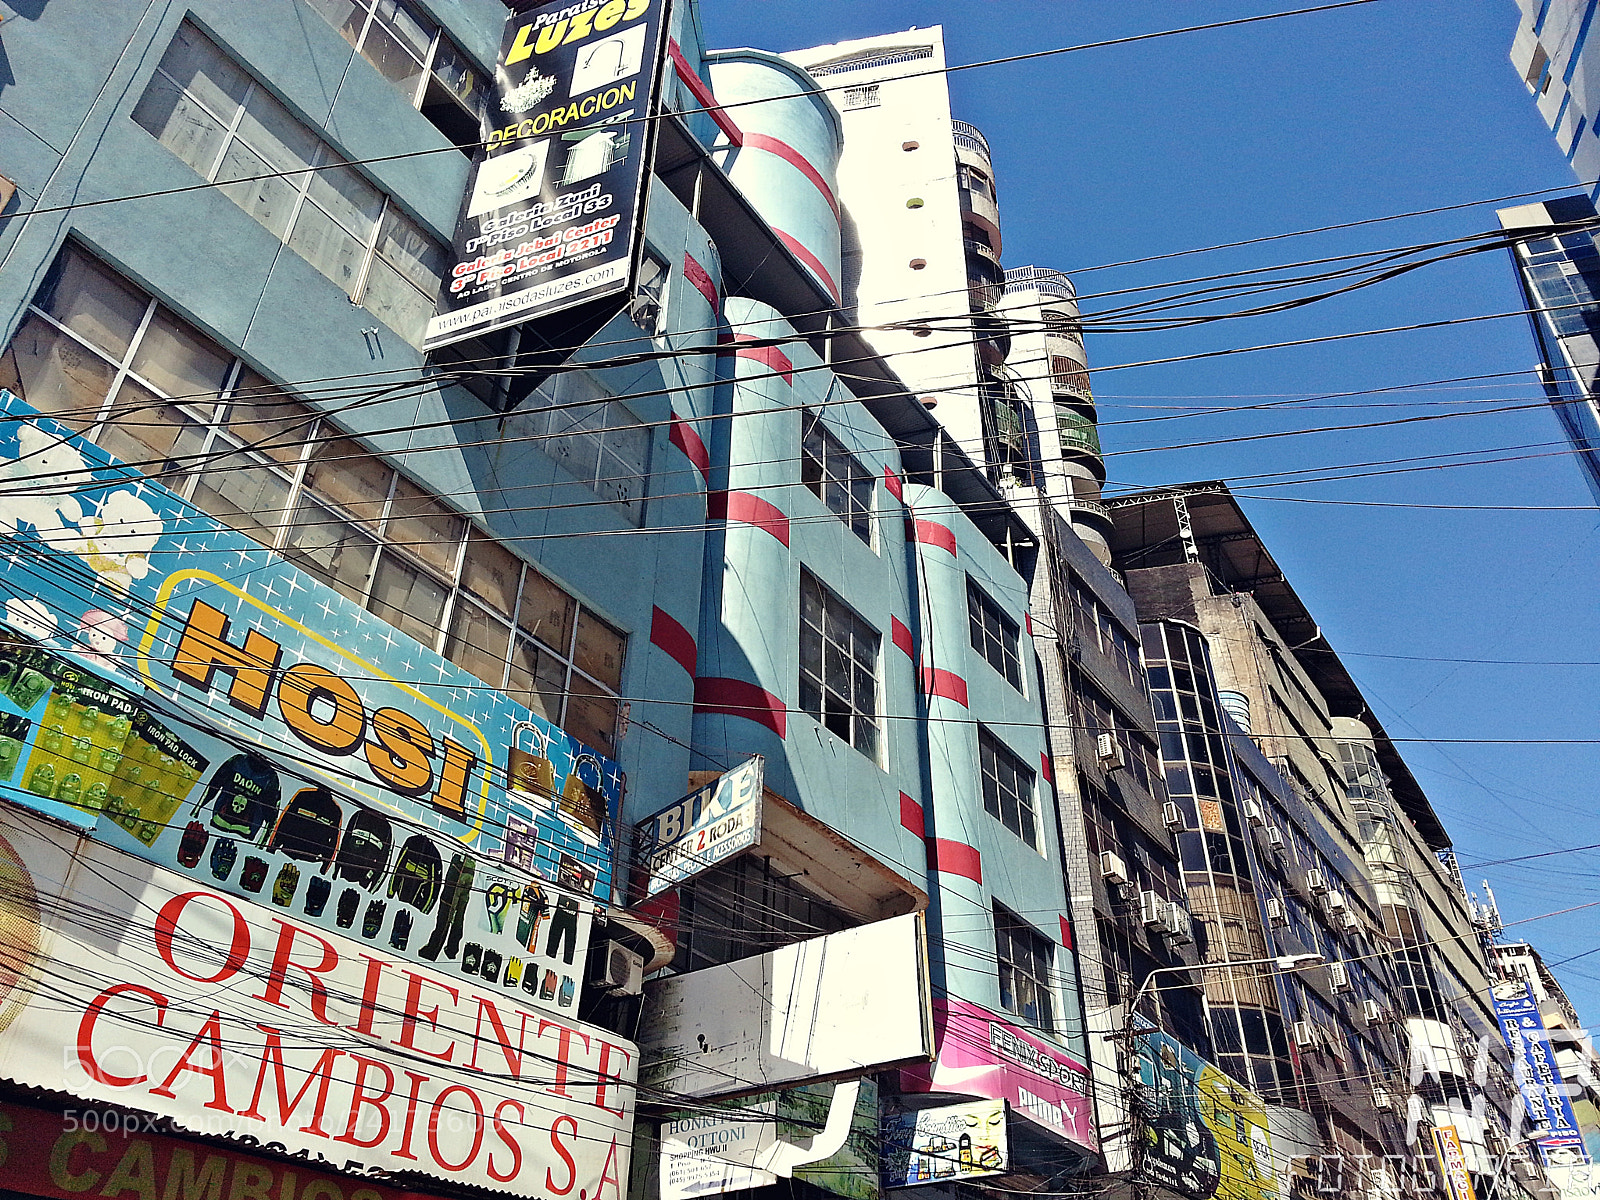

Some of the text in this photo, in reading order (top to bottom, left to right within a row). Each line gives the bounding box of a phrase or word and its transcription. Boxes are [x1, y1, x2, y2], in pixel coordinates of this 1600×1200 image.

[486, 80, 636, 151] DECORACION
[481, 183, 601, 233] Galeria Zuni
[486, 224, 529, 247] Piso
[529, 203, 582, 232] Local
[583, 194, 613, 214] 33
[452, 214, 621, 278] Galeria Jebai Center
[457, 247, 608, 300] AO LADO CENTRO DE MOTOROLA
[476, 263, 516, 285] Piso
[516, 246, 564, 272] Local
[565, 229, 613, 257] 2211
[82, 687, 109, 704] IRON
[110, 695, 132, 713] PAD
[171, 597, 477, 824] HOSI
[147, 725, 199, 768] IRON PAD LOCK
[657, 765, 755, 841] BIKE
[697, 830, 705, 851] 2
[154, 891, 632, 1120] ORIENTE
[77, 982, 524, 1183] CAMBIOS
[1503, 1019, 1552, 1130] RESTAURANTE
[1527, 1031, 1571, 1129] CAFETERIA
[50, 1127, 383, 1200] CAMBI
[688, 1126, 746, 1149] OTTONI
